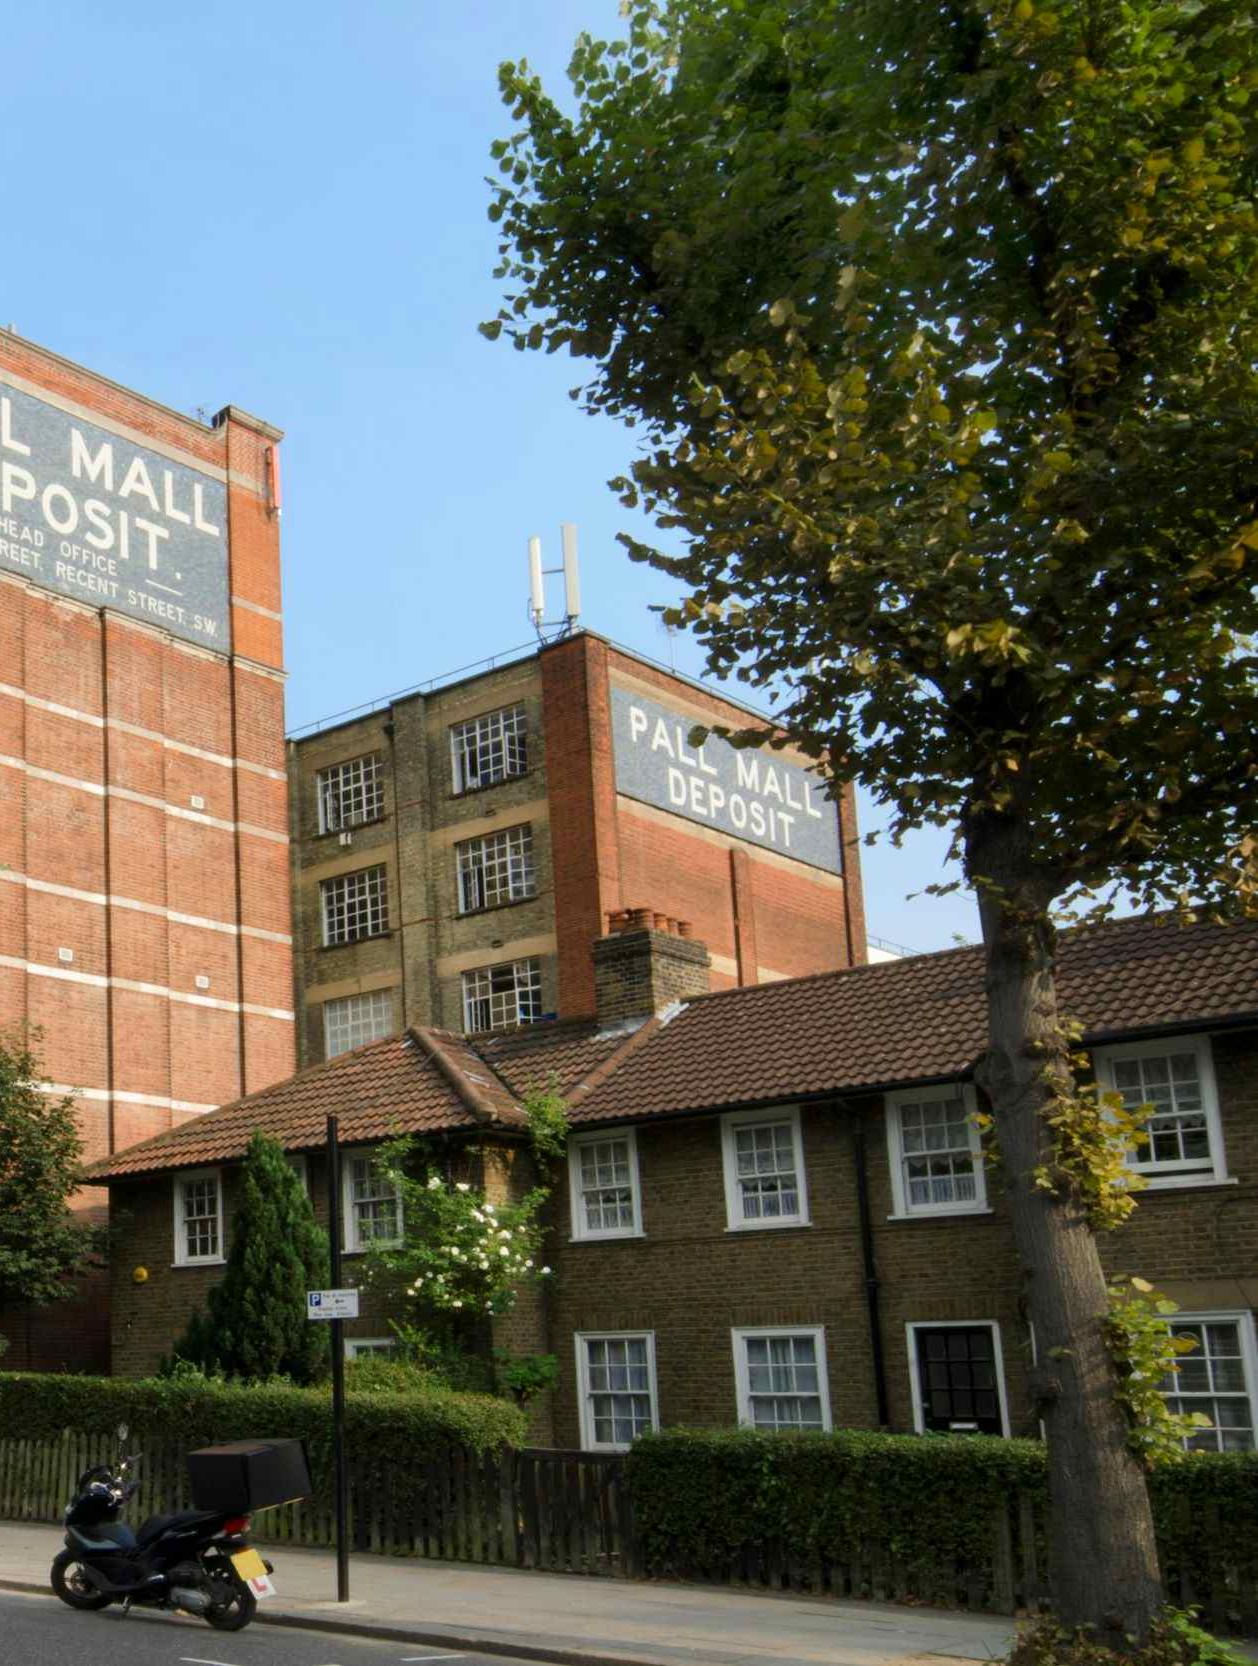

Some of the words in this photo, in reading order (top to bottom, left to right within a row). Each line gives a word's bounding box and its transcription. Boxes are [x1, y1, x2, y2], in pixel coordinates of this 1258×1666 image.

[71, 428, 220, 537] MALL
[60, 541, 118, 577] OFFICE
[629, 705, 718, 776] PALL
[736, 751, 822, 819] MALL
[668, 767, 795, 847] DEPOSIT
